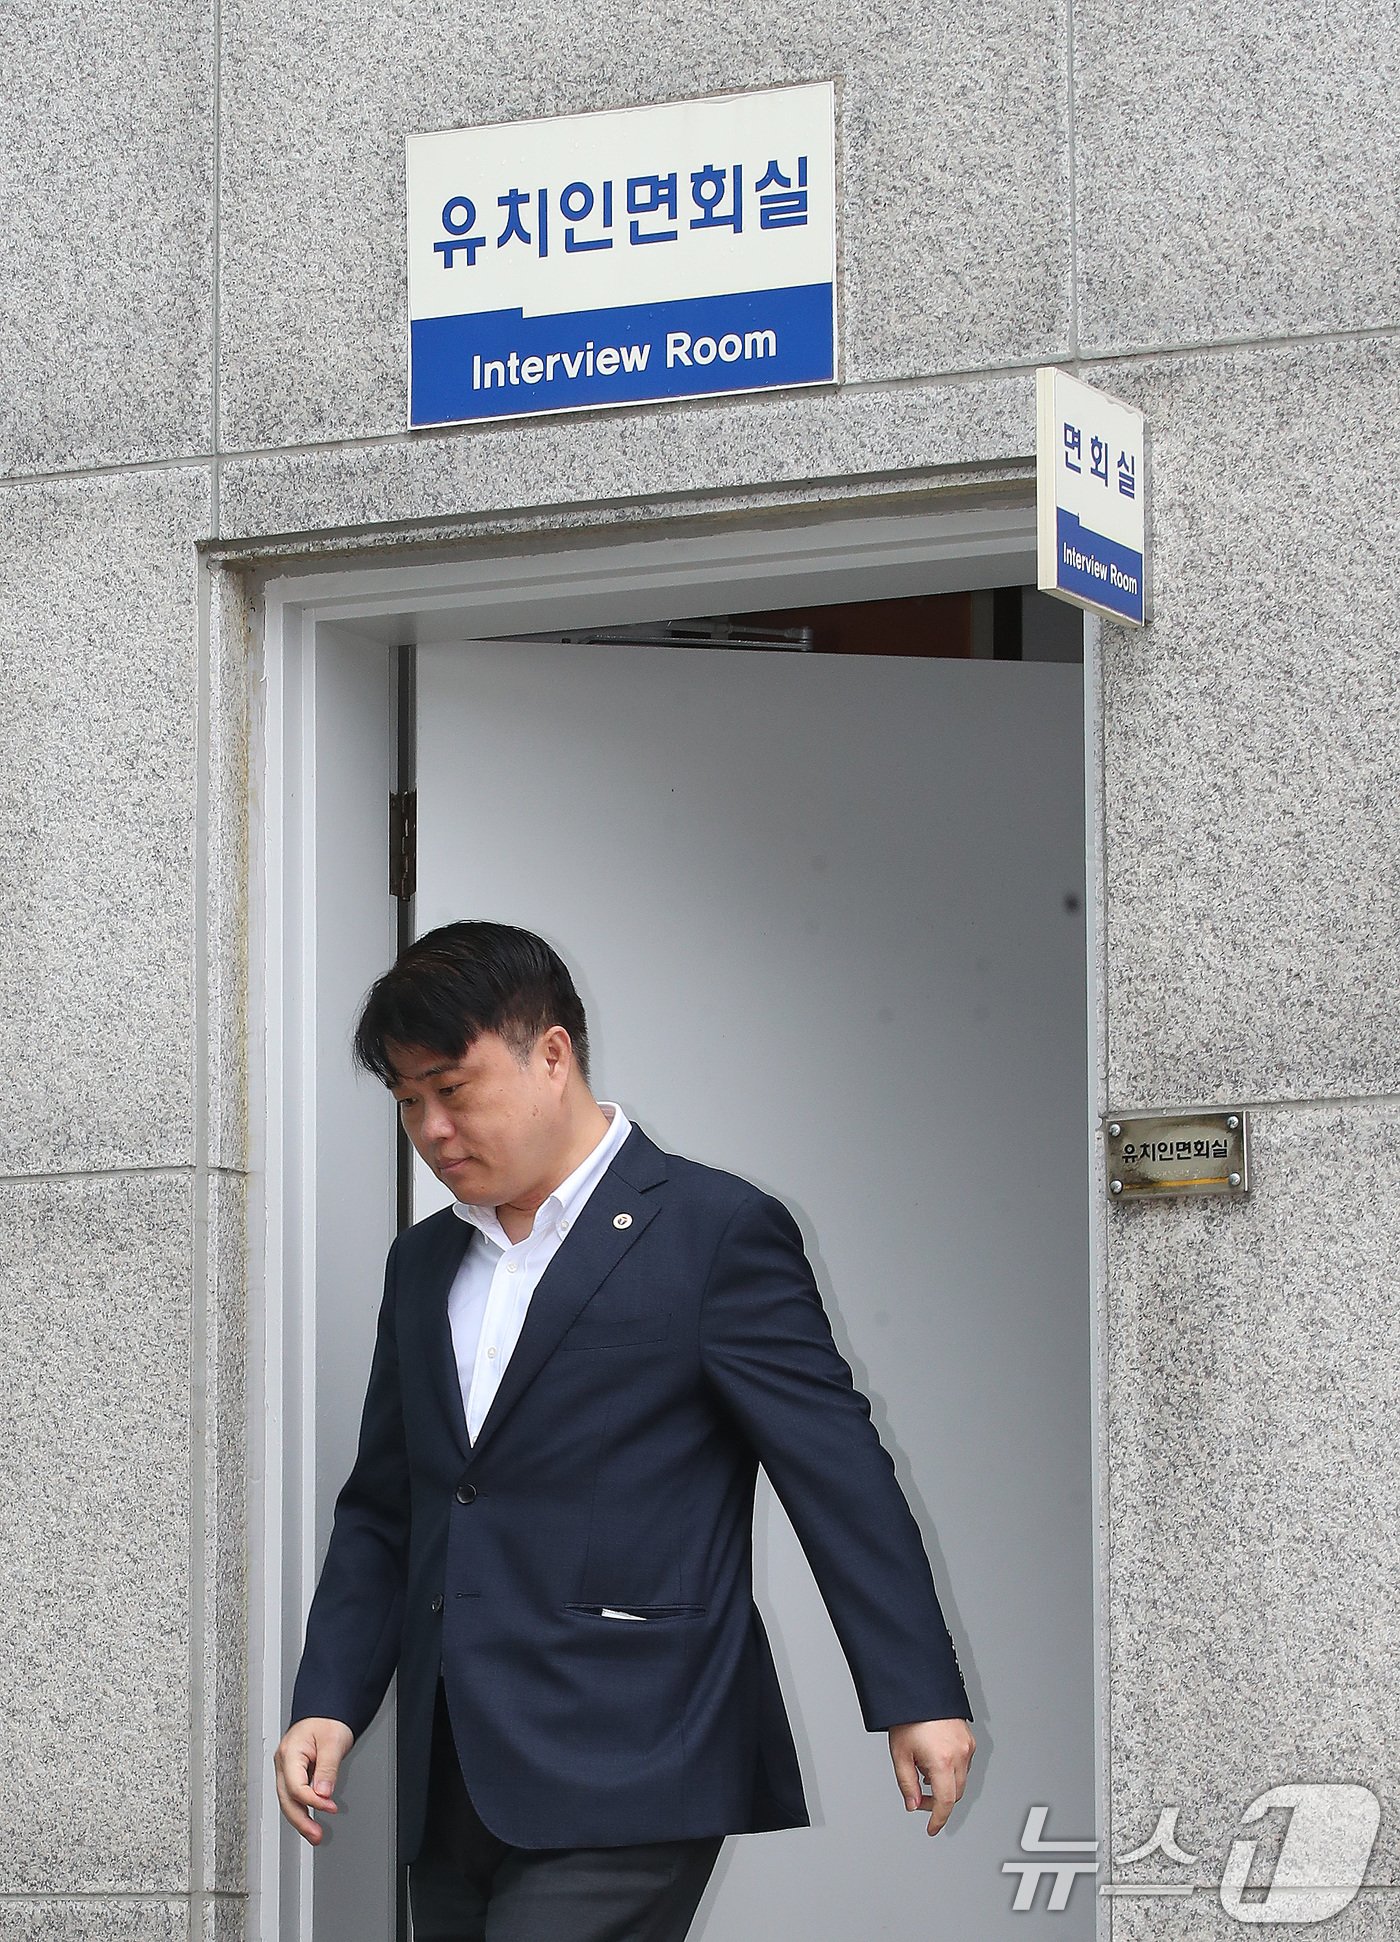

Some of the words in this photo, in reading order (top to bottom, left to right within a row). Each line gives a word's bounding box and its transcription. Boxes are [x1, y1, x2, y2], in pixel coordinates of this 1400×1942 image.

[433, 155, 809, 270] 유치인면회실
[472, 341, 651, 391] Interview
[666, 328, 778, 369] Room
[1063, 541, 1108, 581] Interview
[1110, 563, 1138, 596] Room
[1121, 1139, 1228, 1164] 유치인면회실
